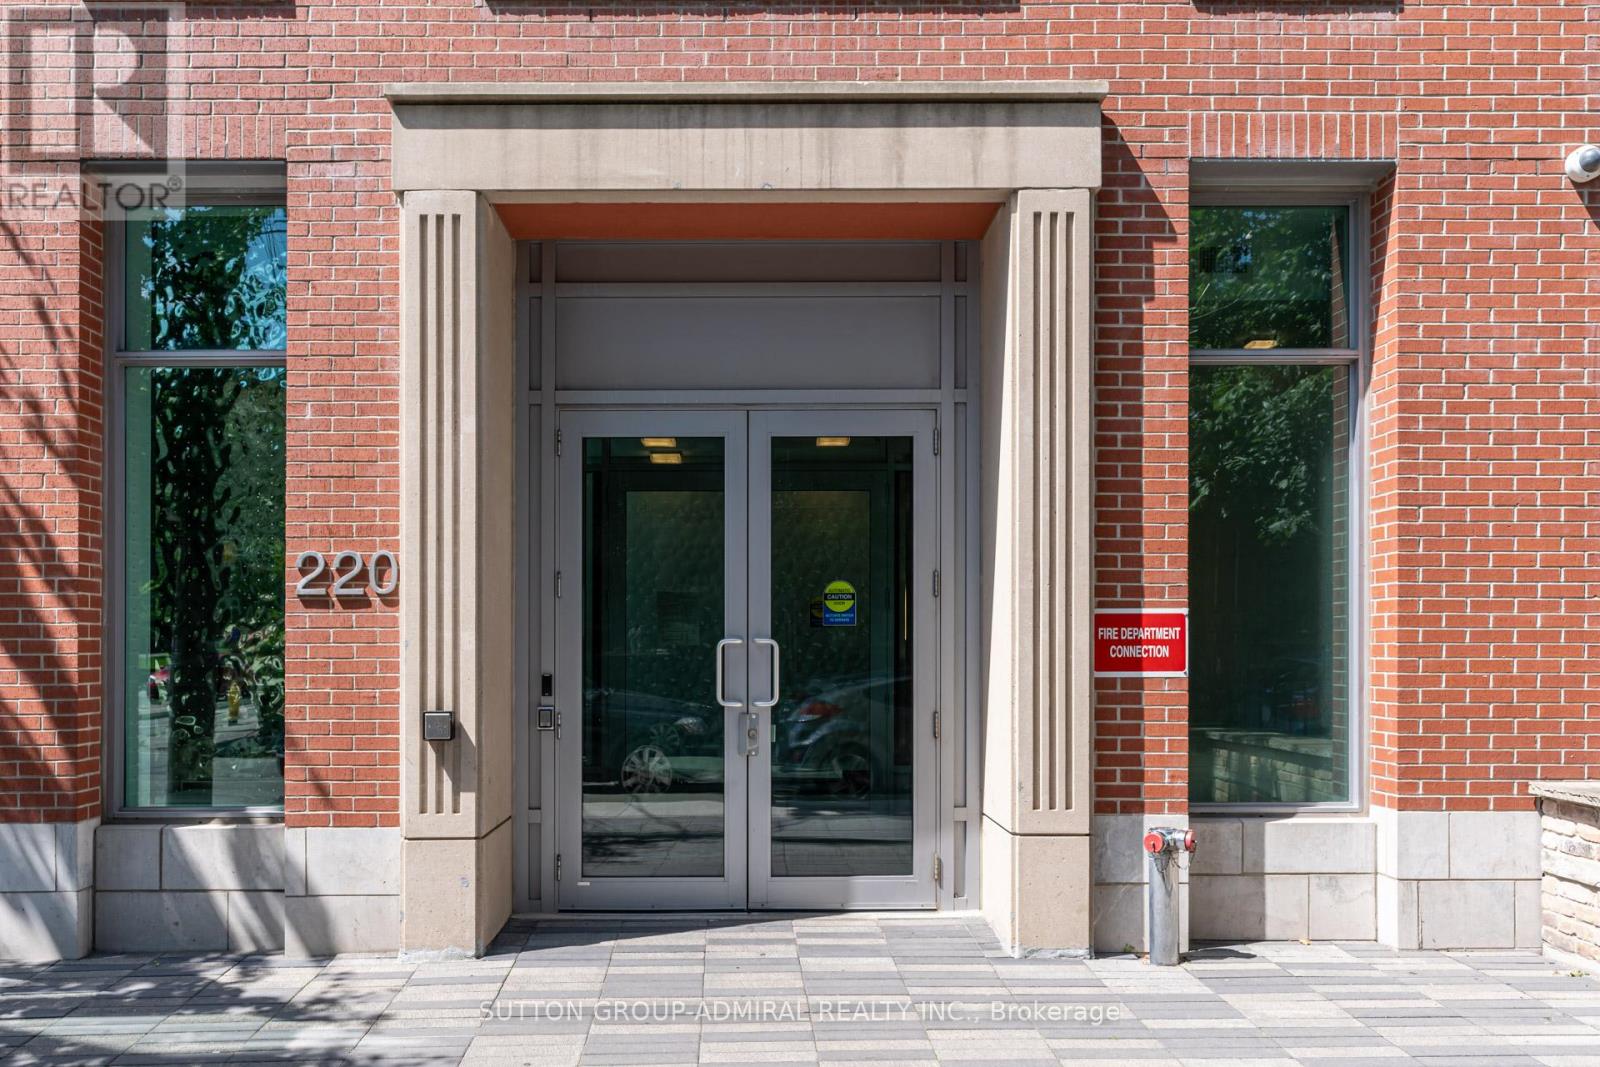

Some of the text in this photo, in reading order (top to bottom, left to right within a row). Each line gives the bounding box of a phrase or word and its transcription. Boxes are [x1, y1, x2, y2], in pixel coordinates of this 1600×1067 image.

[295, 549, 399, 596] 220
[1098, 627, 1181, 640] FIRE DEPARTMENT
[1109, 645, 1170, 658] CONNECTION
